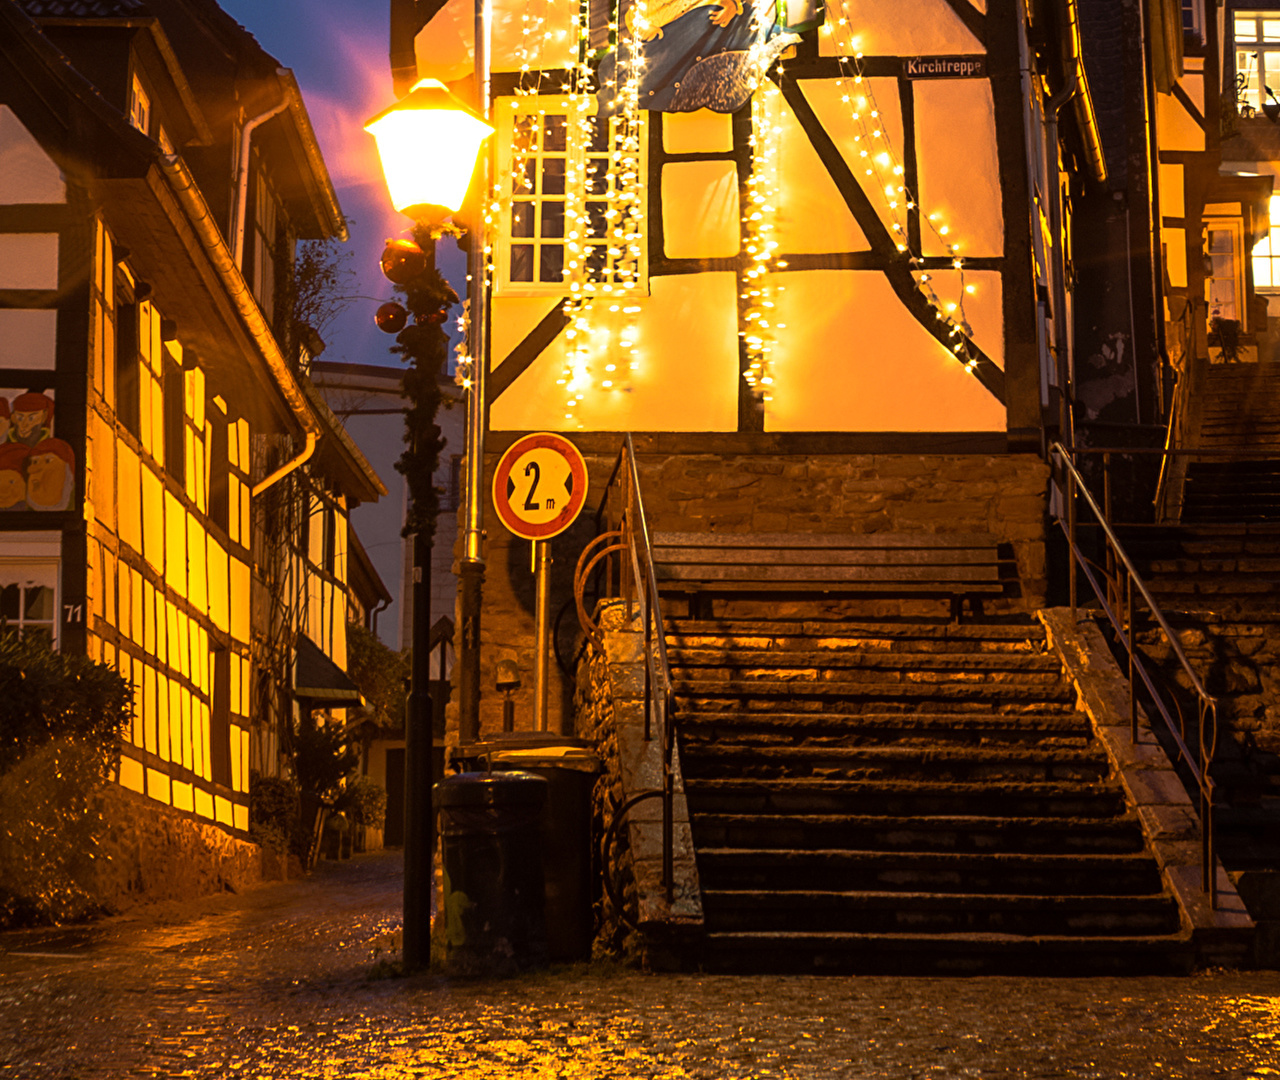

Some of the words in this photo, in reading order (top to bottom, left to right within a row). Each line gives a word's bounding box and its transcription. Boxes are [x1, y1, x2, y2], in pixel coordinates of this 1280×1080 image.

[908, 58, 981, 76] Kirchtreppe
[524, 461, 540, 510] 2
[546, 498, 556, 510] m
[63, 605, 82, 623] 71
